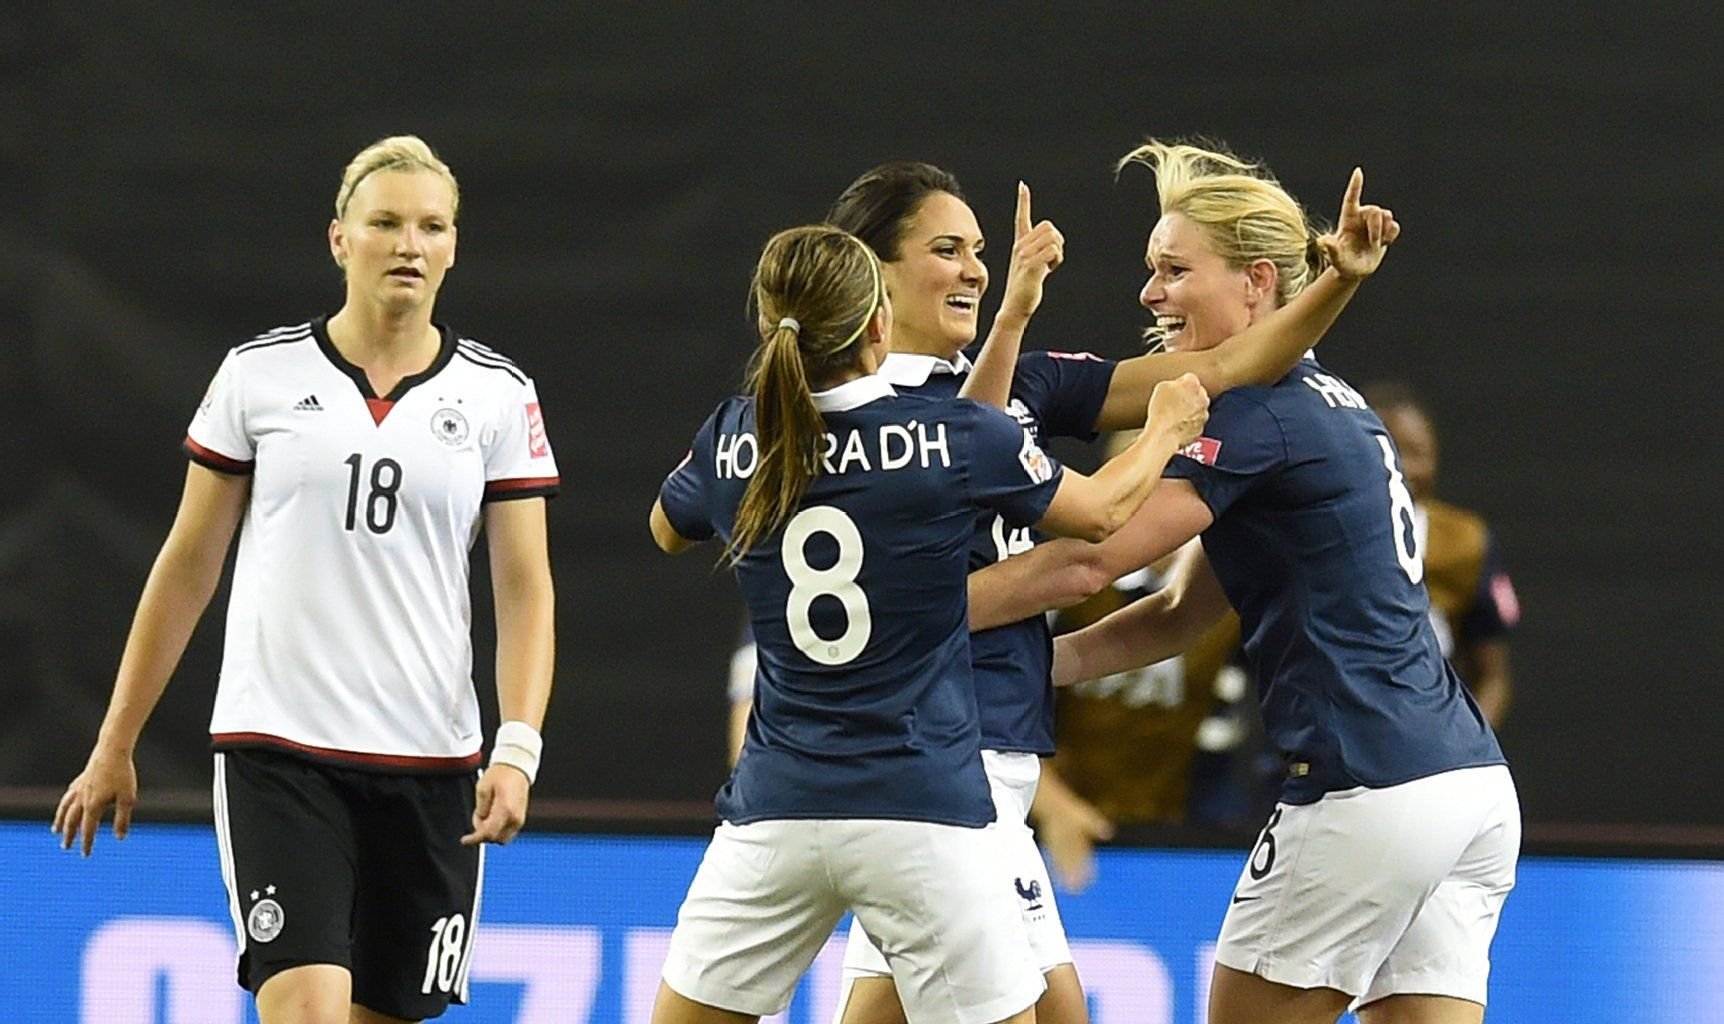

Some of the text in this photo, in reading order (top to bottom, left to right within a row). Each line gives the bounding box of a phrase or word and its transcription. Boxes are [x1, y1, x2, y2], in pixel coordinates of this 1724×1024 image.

[344, 453, 403, 535] 18
[715, 429, 871, 479] HORA
[1375, 434, 1424, 585] 6
[782, 505, 872, 665] 8
[421, 913, 465, 995] 18
